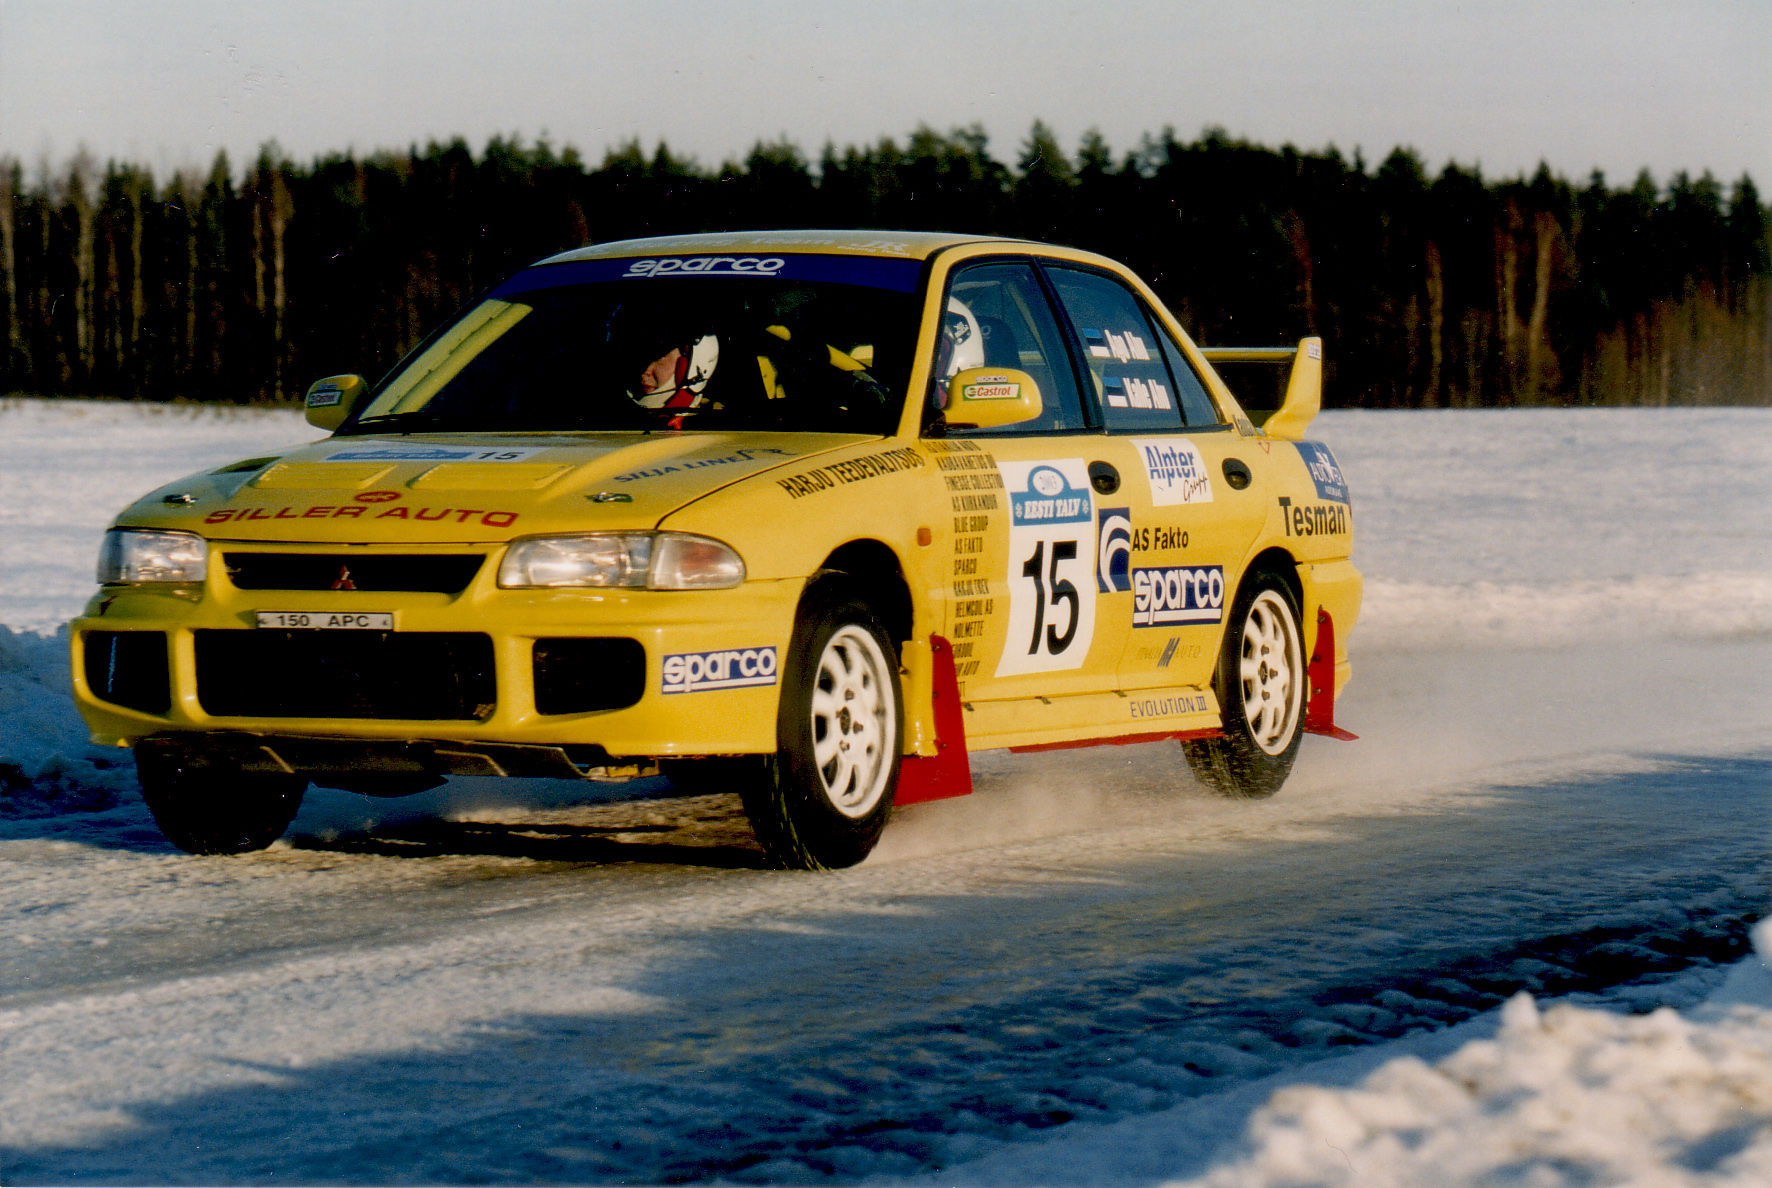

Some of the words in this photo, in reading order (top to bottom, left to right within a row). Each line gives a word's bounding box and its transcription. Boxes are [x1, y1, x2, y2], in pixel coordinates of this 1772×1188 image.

[626, 257, 785, 277] sparco
[977, 386, 1012, 397] Castrol
[477, 451, 524, 460] 15
[1145, 446, 1197, 487] Alpter
[613, 466, 681, 483] SILJA
[777, 469, 835, 499] HARJU
[204, 506, 368, 525] SILLER
[375, 507, 519, 528] AUTO
[1024, 500, 1054, 519] EESTI
[1055, 498, 1081, 517] TALV
[1278, 496, 1346, 537] Tesman
[954, 538, 963, 554] AS
[1132, 528, 1150, 551] AS
[1154, 527, 1189, 550] Fakto
[1022, 540, 1080, 655] 15
[1134, 568, 1225, 626] sparco
[276, 614, 310, 627] 150
[327, 615, 369, 628] APC
[663, 647, 777, 693] sparco
[1130, 697, 1195, 718] EVOLUTION
[1195, 696, 1209, 711] III
